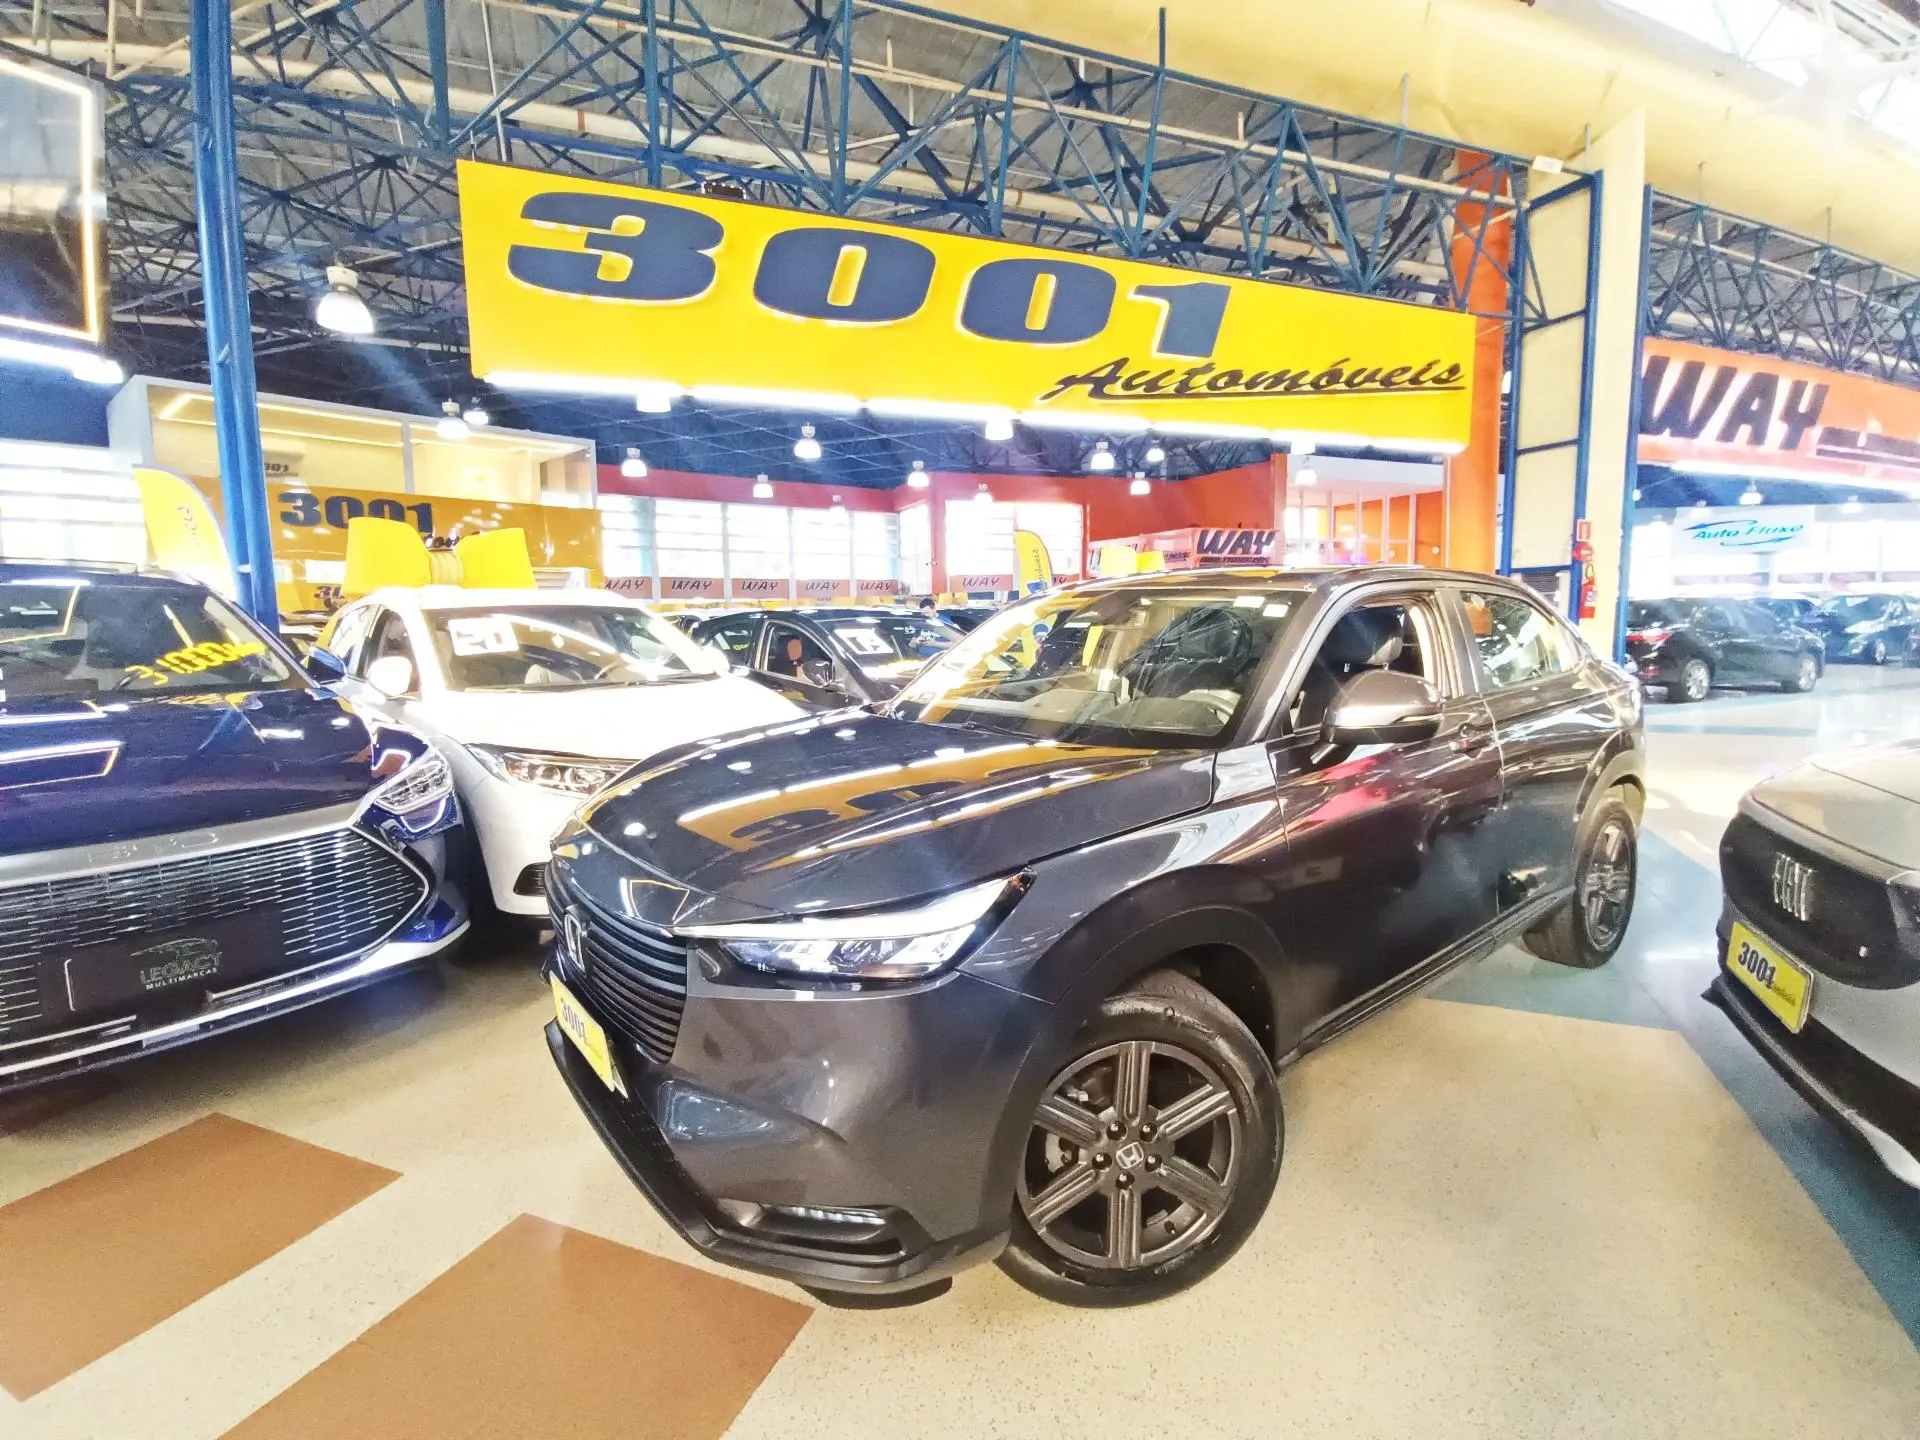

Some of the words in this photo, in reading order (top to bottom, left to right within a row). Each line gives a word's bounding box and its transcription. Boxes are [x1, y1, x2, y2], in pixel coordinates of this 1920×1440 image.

[508, 191, 1232, 359] 3001
[1039, 356, 1466, 401] Automóveis
[1640, 354, 1830, 452] WAY
[1196, 529, 1276, 555] WAY
[671, 579, 713, 591] WAY
[741, 580, 779, 591] WAY
[805, 581, 840, 591] WAY
[860, 581, 893, 591] WAY
[962, 577, 1000, 588] WAY
[1737, 940, 1777, 990] 3001
